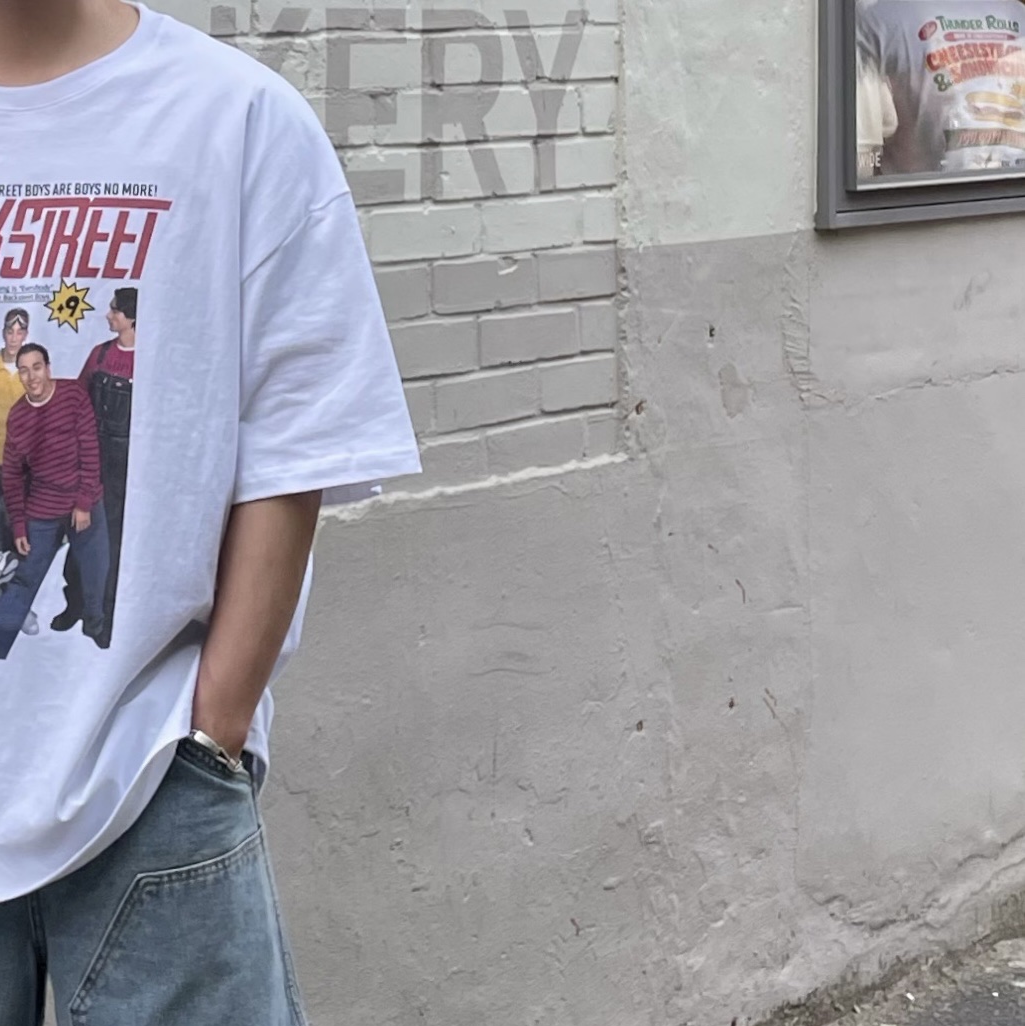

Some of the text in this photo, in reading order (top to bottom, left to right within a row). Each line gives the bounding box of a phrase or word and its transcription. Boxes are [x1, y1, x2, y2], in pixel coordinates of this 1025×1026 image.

[935, 14, 1019, 33] THUNDER ROLLS
[25, 184, 50, 197] BOYS
[53, 183, 72, 196] ARE
[74, 182, 101, 196] BOYS
[104, 182, 120, 196] NO
[122, 183, 158, 197] MORE!
